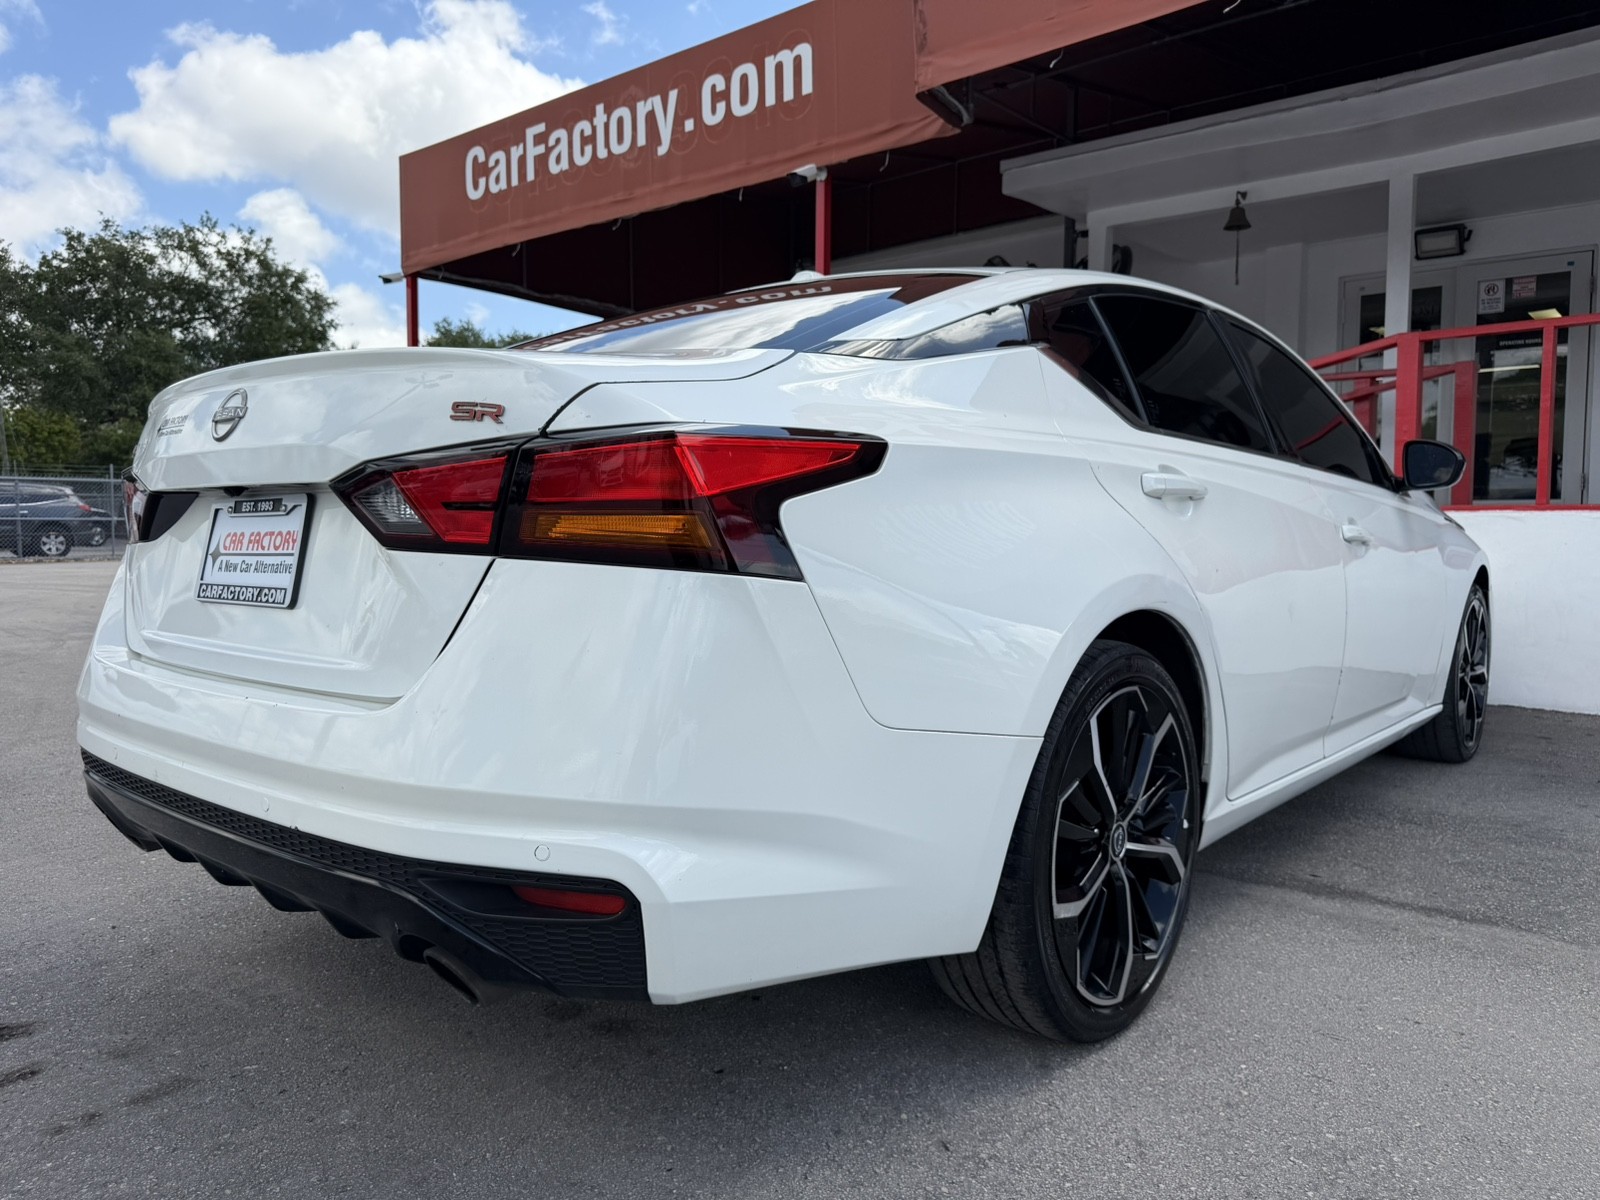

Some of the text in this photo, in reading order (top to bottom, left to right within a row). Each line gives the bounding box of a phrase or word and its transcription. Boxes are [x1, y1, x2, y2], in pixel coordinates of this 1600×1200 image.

[464, 42, 814, 201] CarFactory.com
[449, 401, 506, 424] SR
[241, 501, 274, 512] EST. 1993
[223, 530, 298, 552] CAR FACTORY
[218, 559, 293, 574] A New Car Alternative
[199, 584, 286, 604] CARFACTORY.COM
